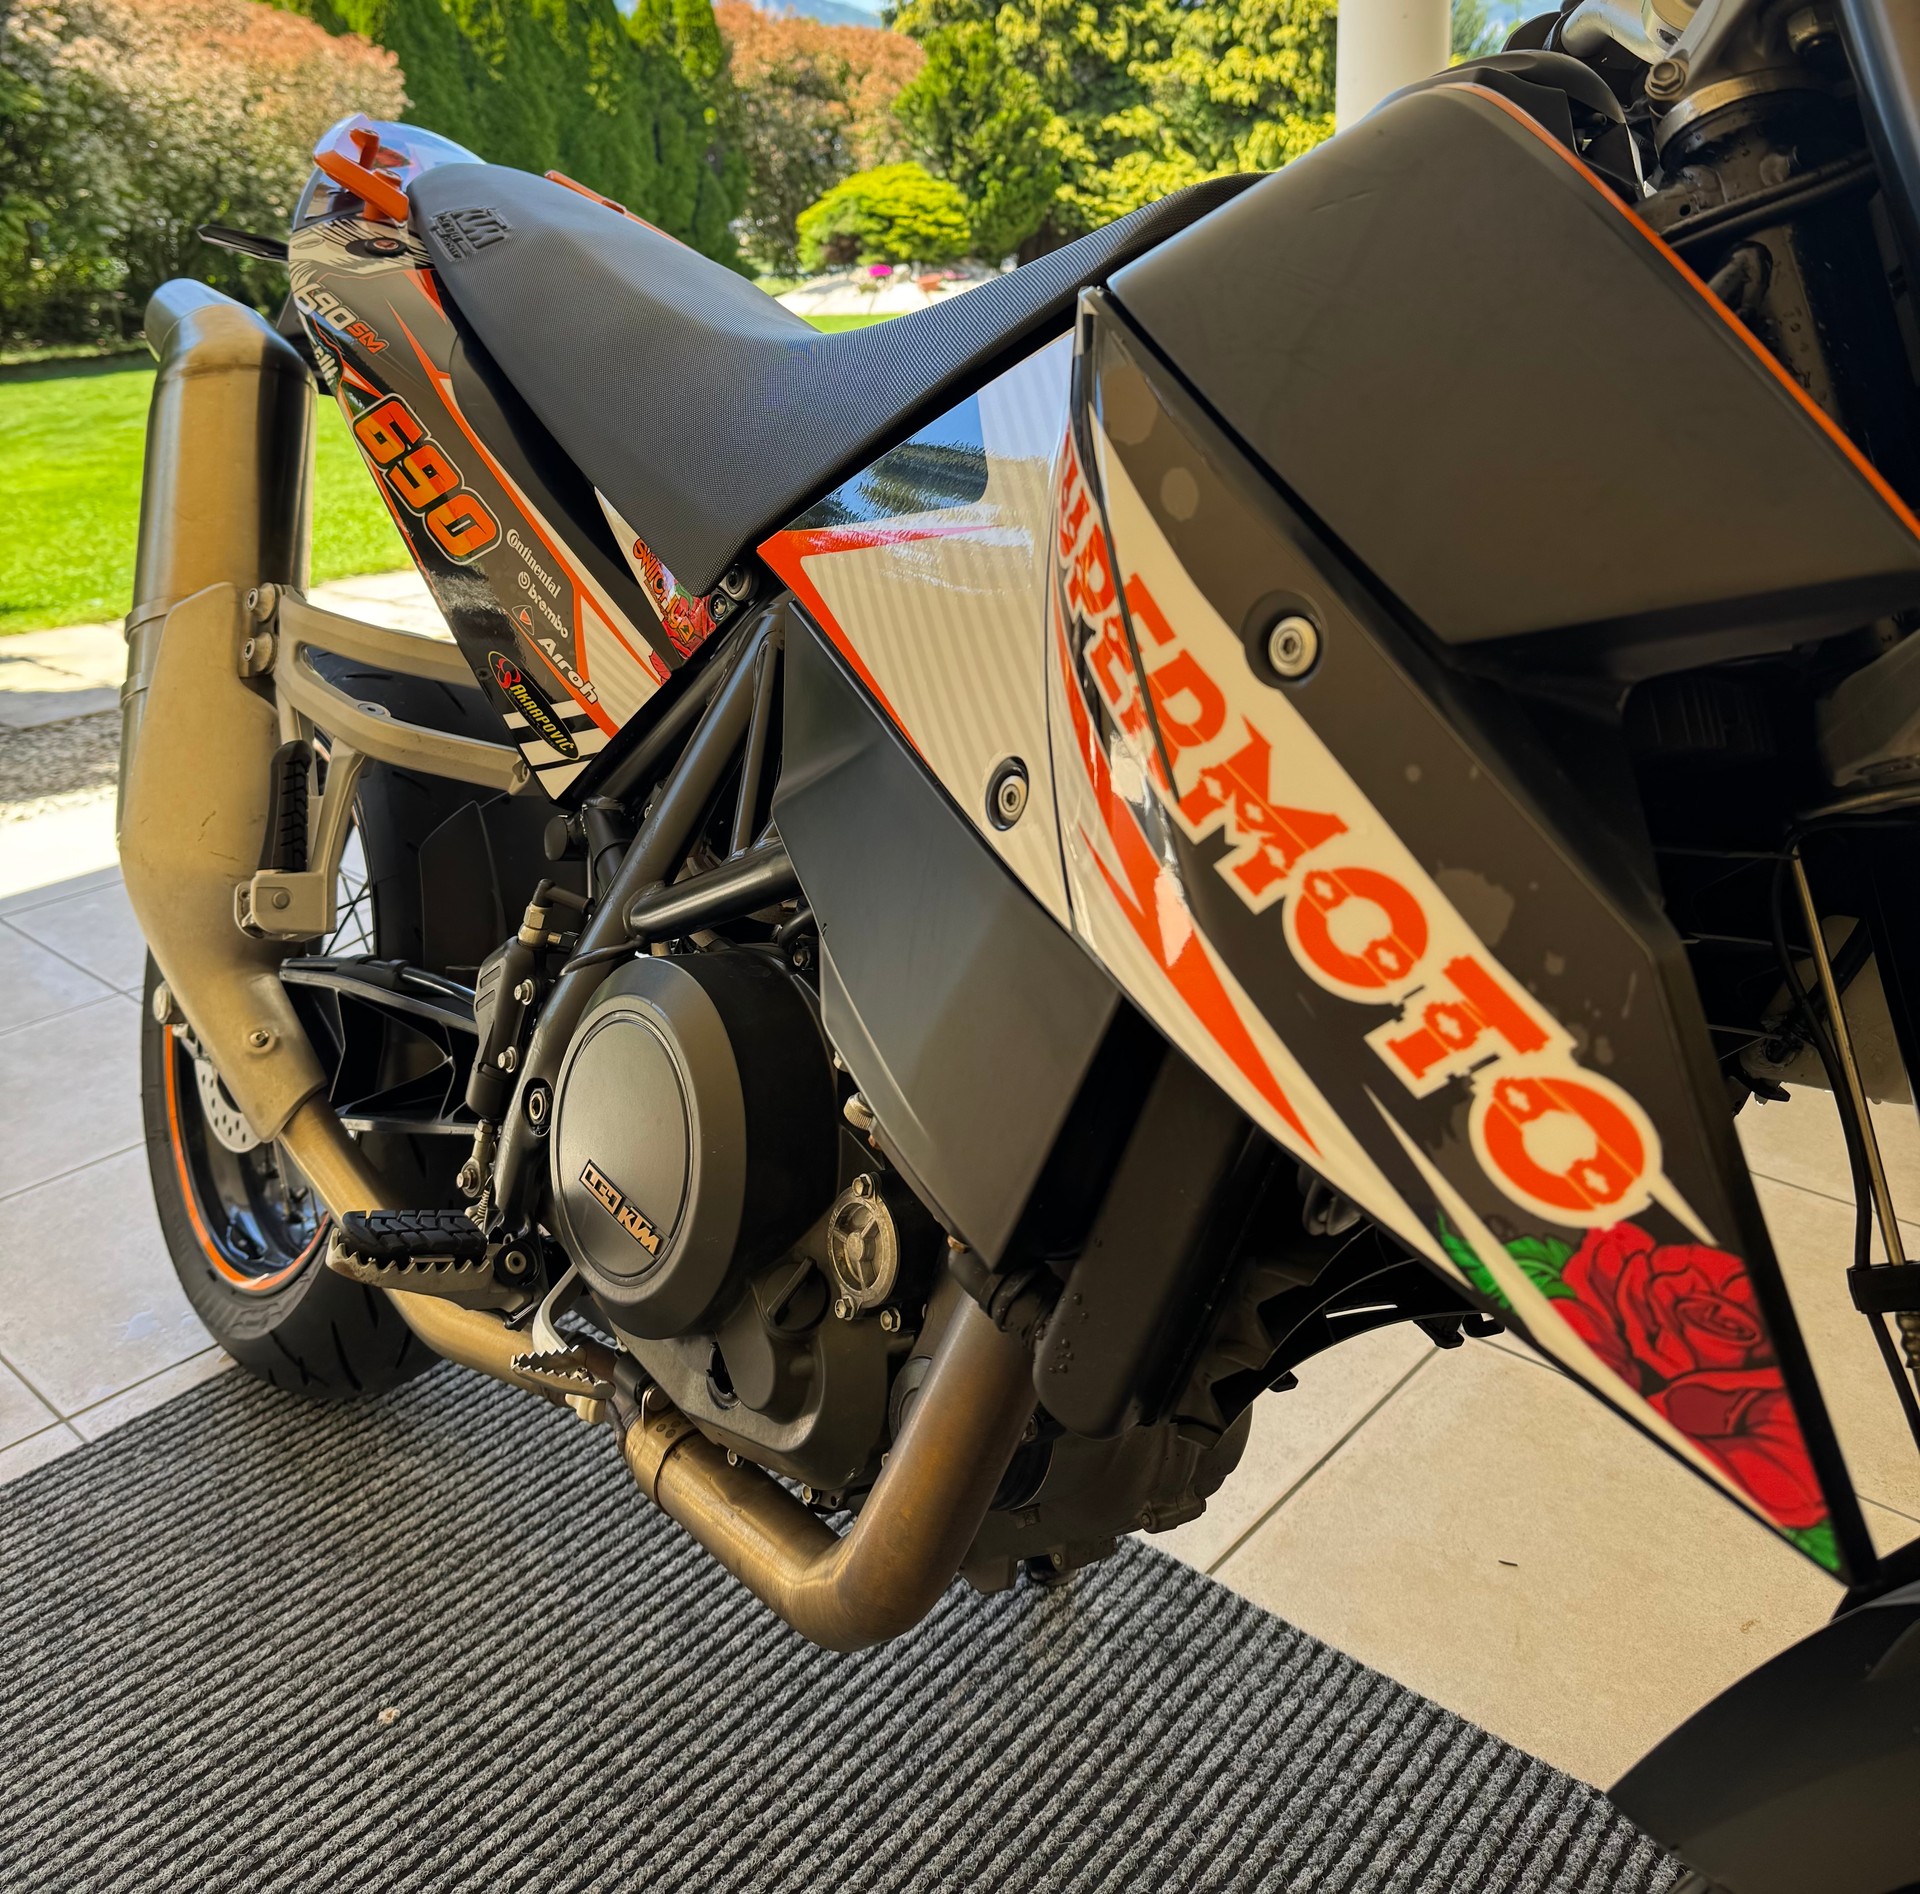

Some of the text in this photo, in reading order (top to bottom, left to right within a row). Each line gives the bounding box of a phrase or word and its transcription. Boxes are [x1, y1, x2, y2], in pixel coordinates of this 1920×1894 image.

[354, 397, 499, 559] 690
[506, 528, 562, 599] Continental
[527, 583, 569, 639] brembo
[537, 638, 599, 705] Airoh
[1059, 430, 1647, 1213] UPERMOTO
[617, 1204, 661, 1257] KTM
